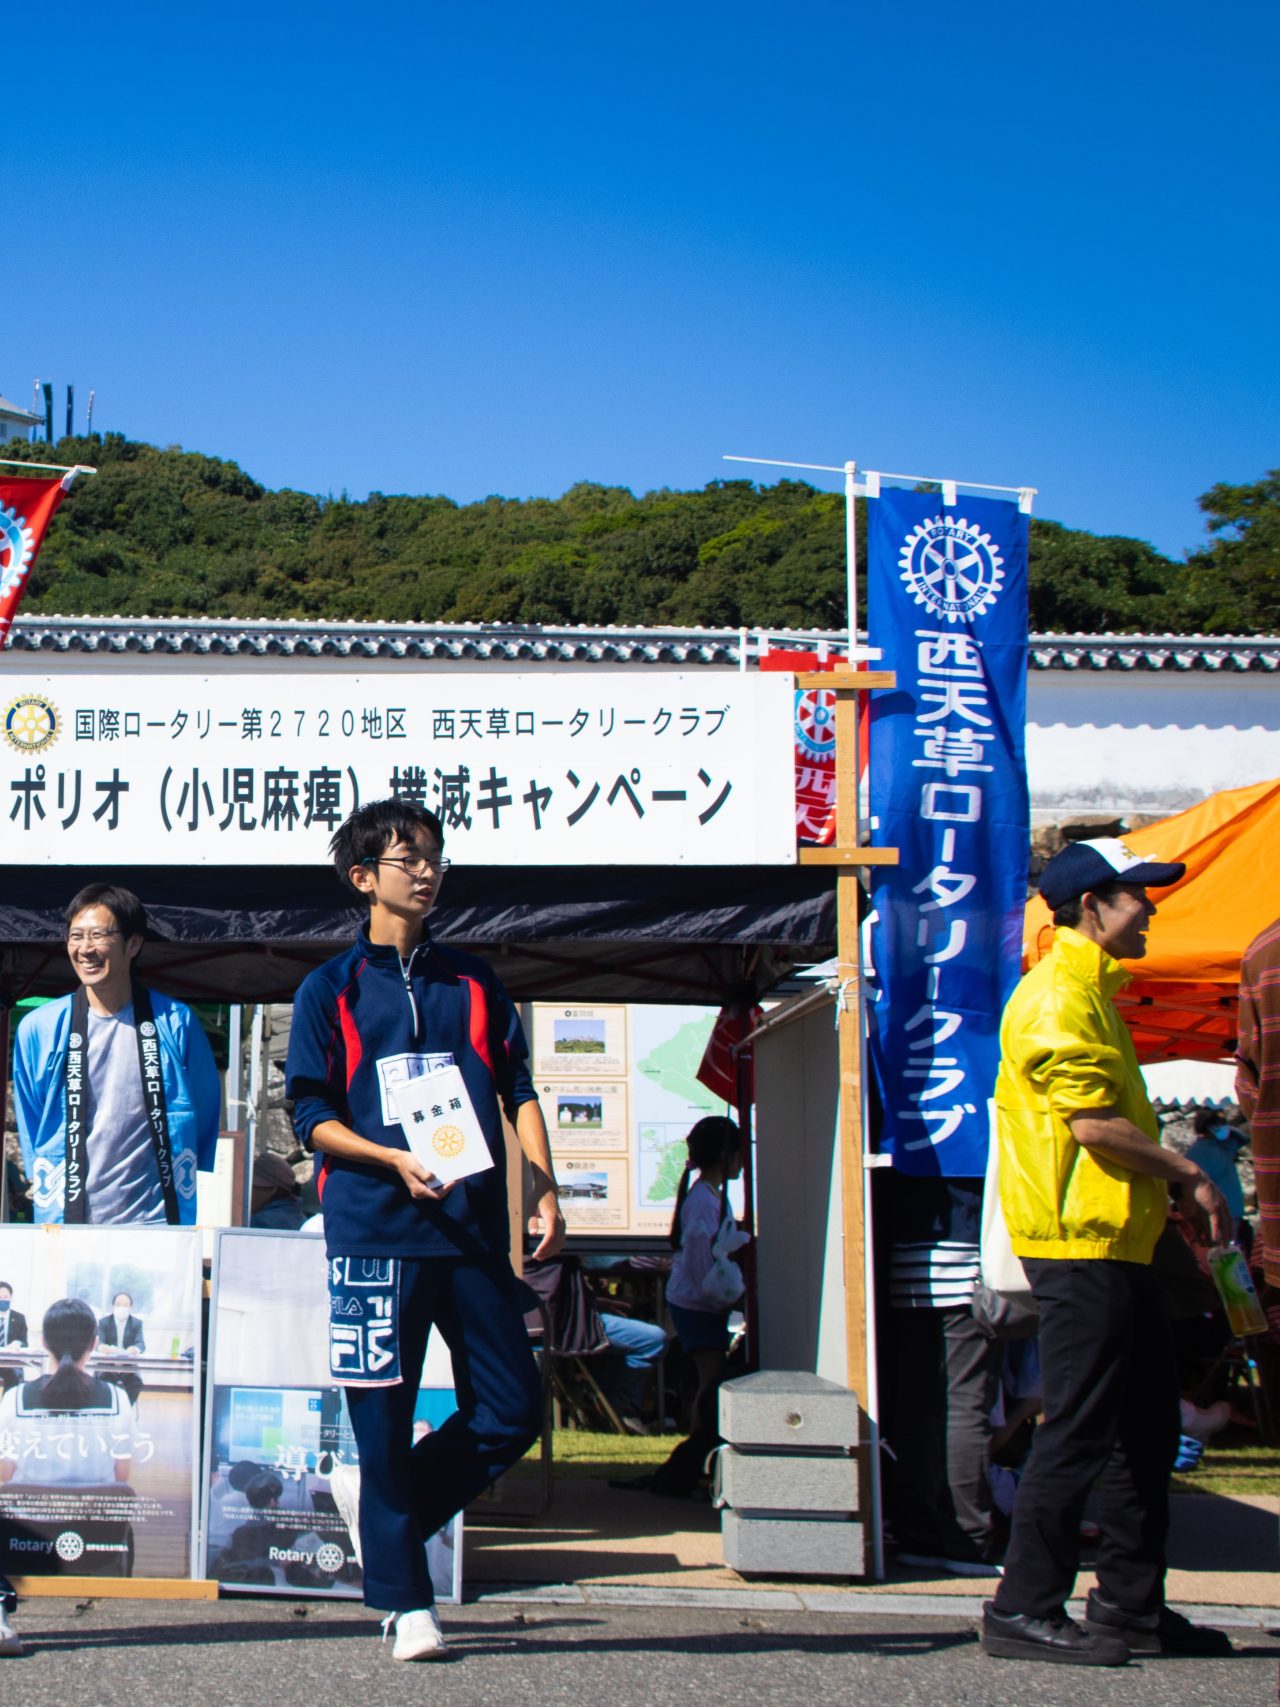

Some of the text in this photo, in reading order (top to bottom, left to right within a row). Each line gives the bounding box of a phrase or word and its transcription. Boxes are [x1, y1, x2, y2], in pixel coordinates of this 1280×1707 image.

[930, 527, 972, 542] ROTARY
[917, 580, 988, 612] INTERNATIONAL
[432, 704, 731, 739] 西天草ロータリークラブ
[898, 629, 995, 1151] 西天草ロータリークラブ
[67, 1051, 82, 1202] 西天草ロータリークラブ
[142, 1038, 172, 1188] 西天草ロータリークラブ
[412, 1097, 462, 1124] 募金箱
[9, 1538, 54, 1554] Rotary
[269, 1546, 314, 1565] Rotary
